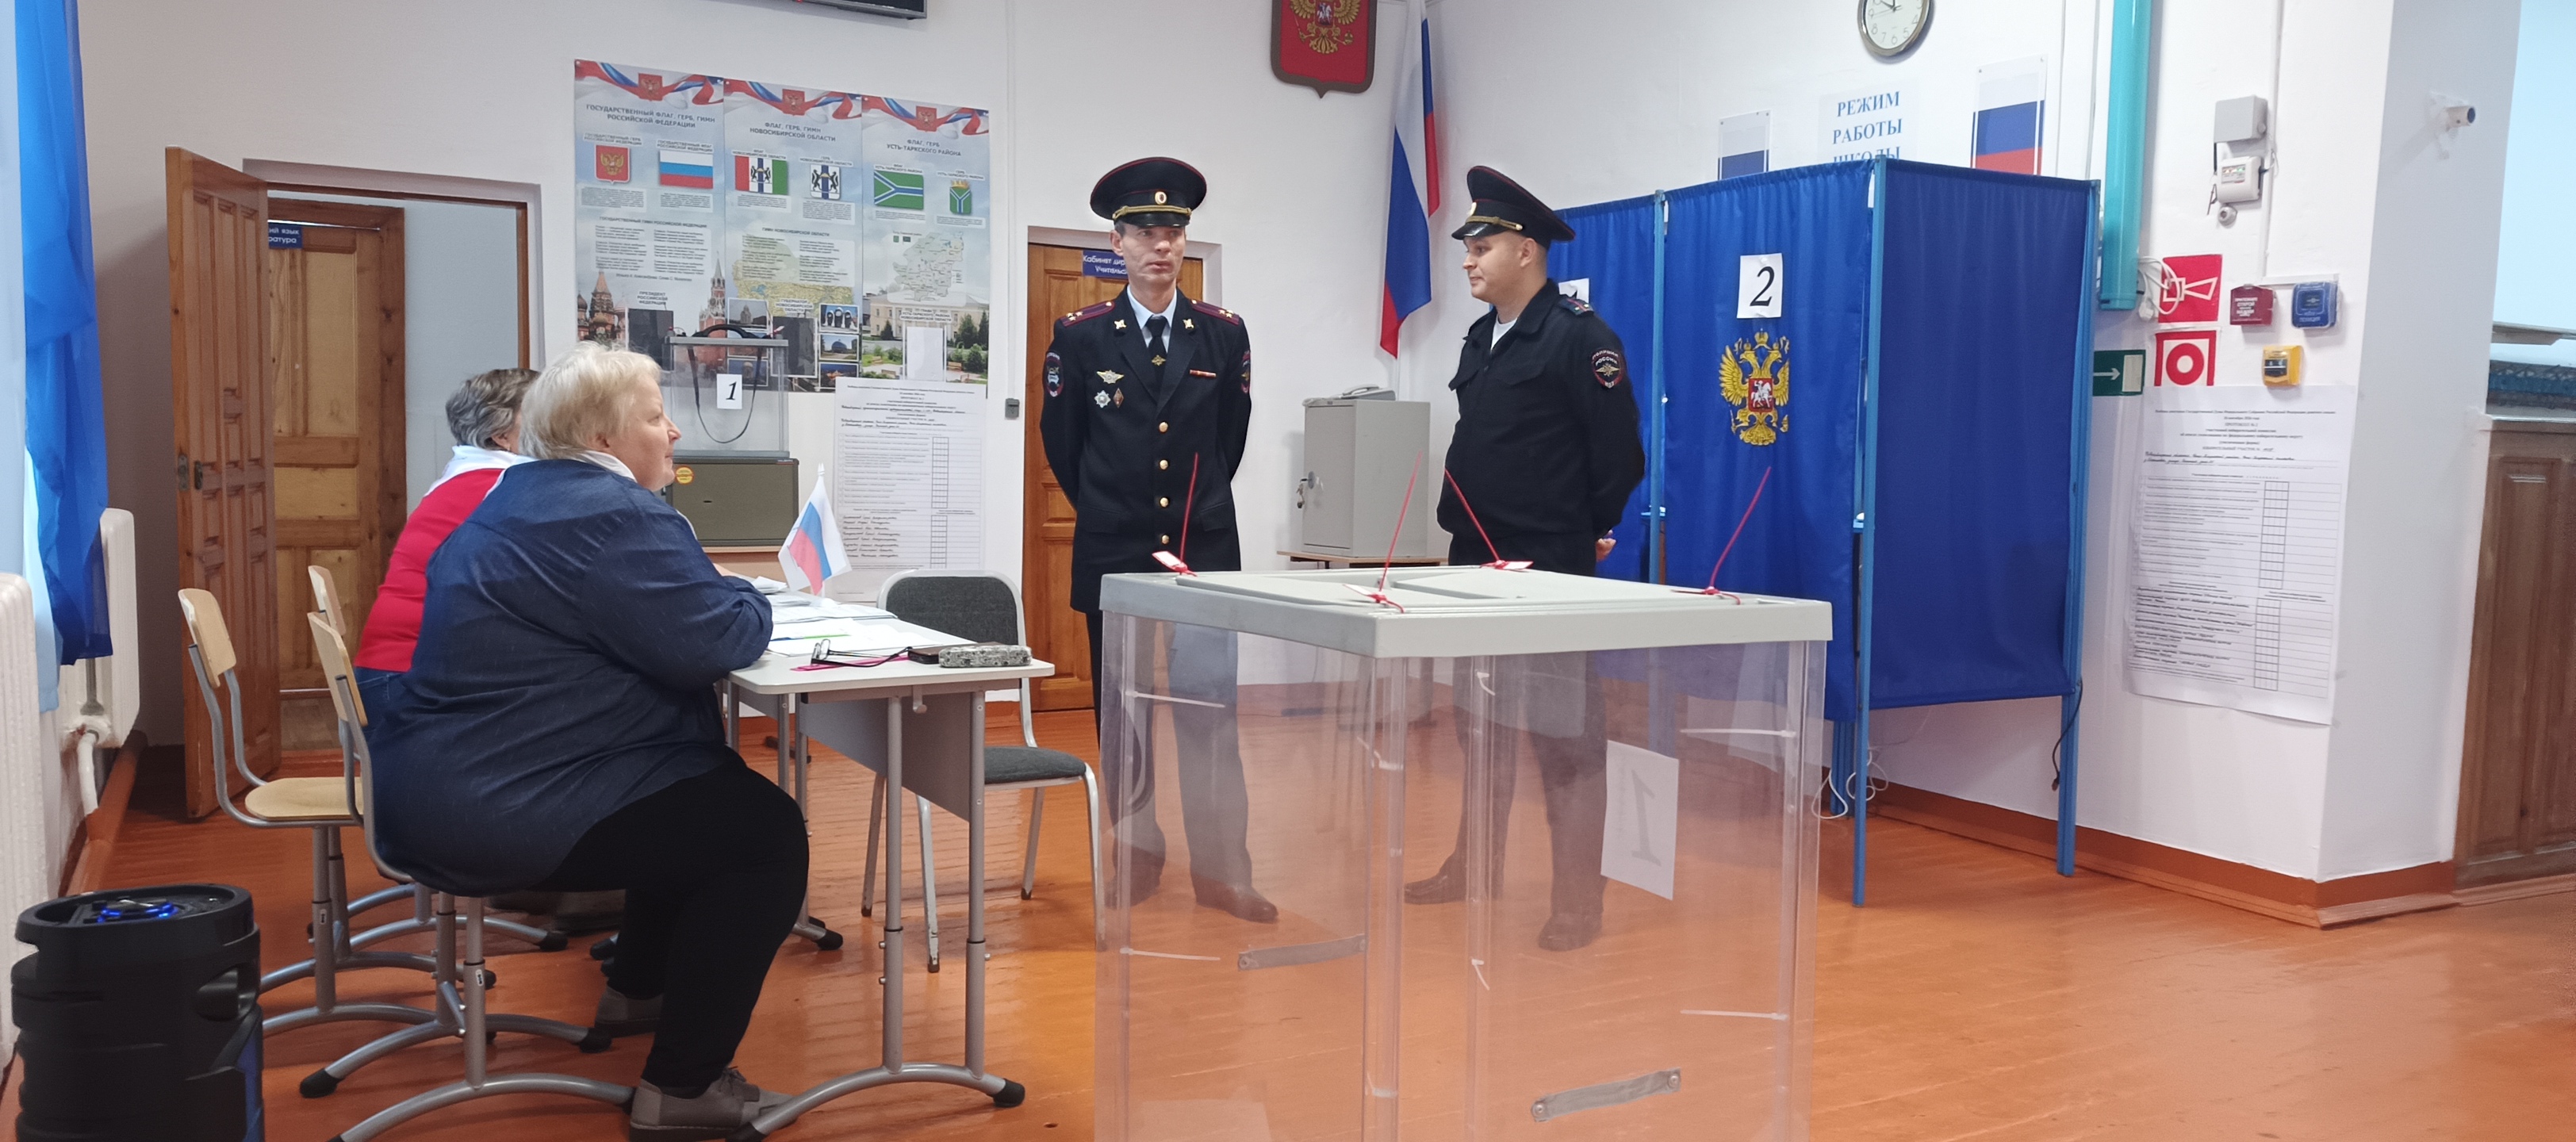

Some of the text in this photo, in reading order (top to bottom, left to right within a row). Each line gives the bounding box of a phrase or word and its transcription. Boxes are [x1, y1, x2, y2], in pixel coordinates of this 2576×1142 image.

[1911, 13, 1919, 25] 4
[1872, 23, 1878, 35] 8
[1880, 32, 1887, 44] 7
[1891, 34, 1898, 45] 6
[1837, 91, 1899, 117] РЕЖИМ
[586, 104, 654, 117] ГОСУДАРСТВЕННЫЙ
[607, 113, 696, 128] РОССИЙСКОЙ ФЕДЕРАЦИИ
[749, 128, 806, 139] НОВОСИБИРСКОЙ
[1833, 118, 1902, 144] РАБОТЫ
[887, 144, 937, 154] УСТЬ-ТАРКСКОГО
[1083, 255, 1112, 264] Кабинет
[1094, 265, 1128, 274] Учительс
[1750, 266, 1775, 307] 2
[1596, 356, 1618, 366] РОССИИ
[726, 381, 738, 400] 1
